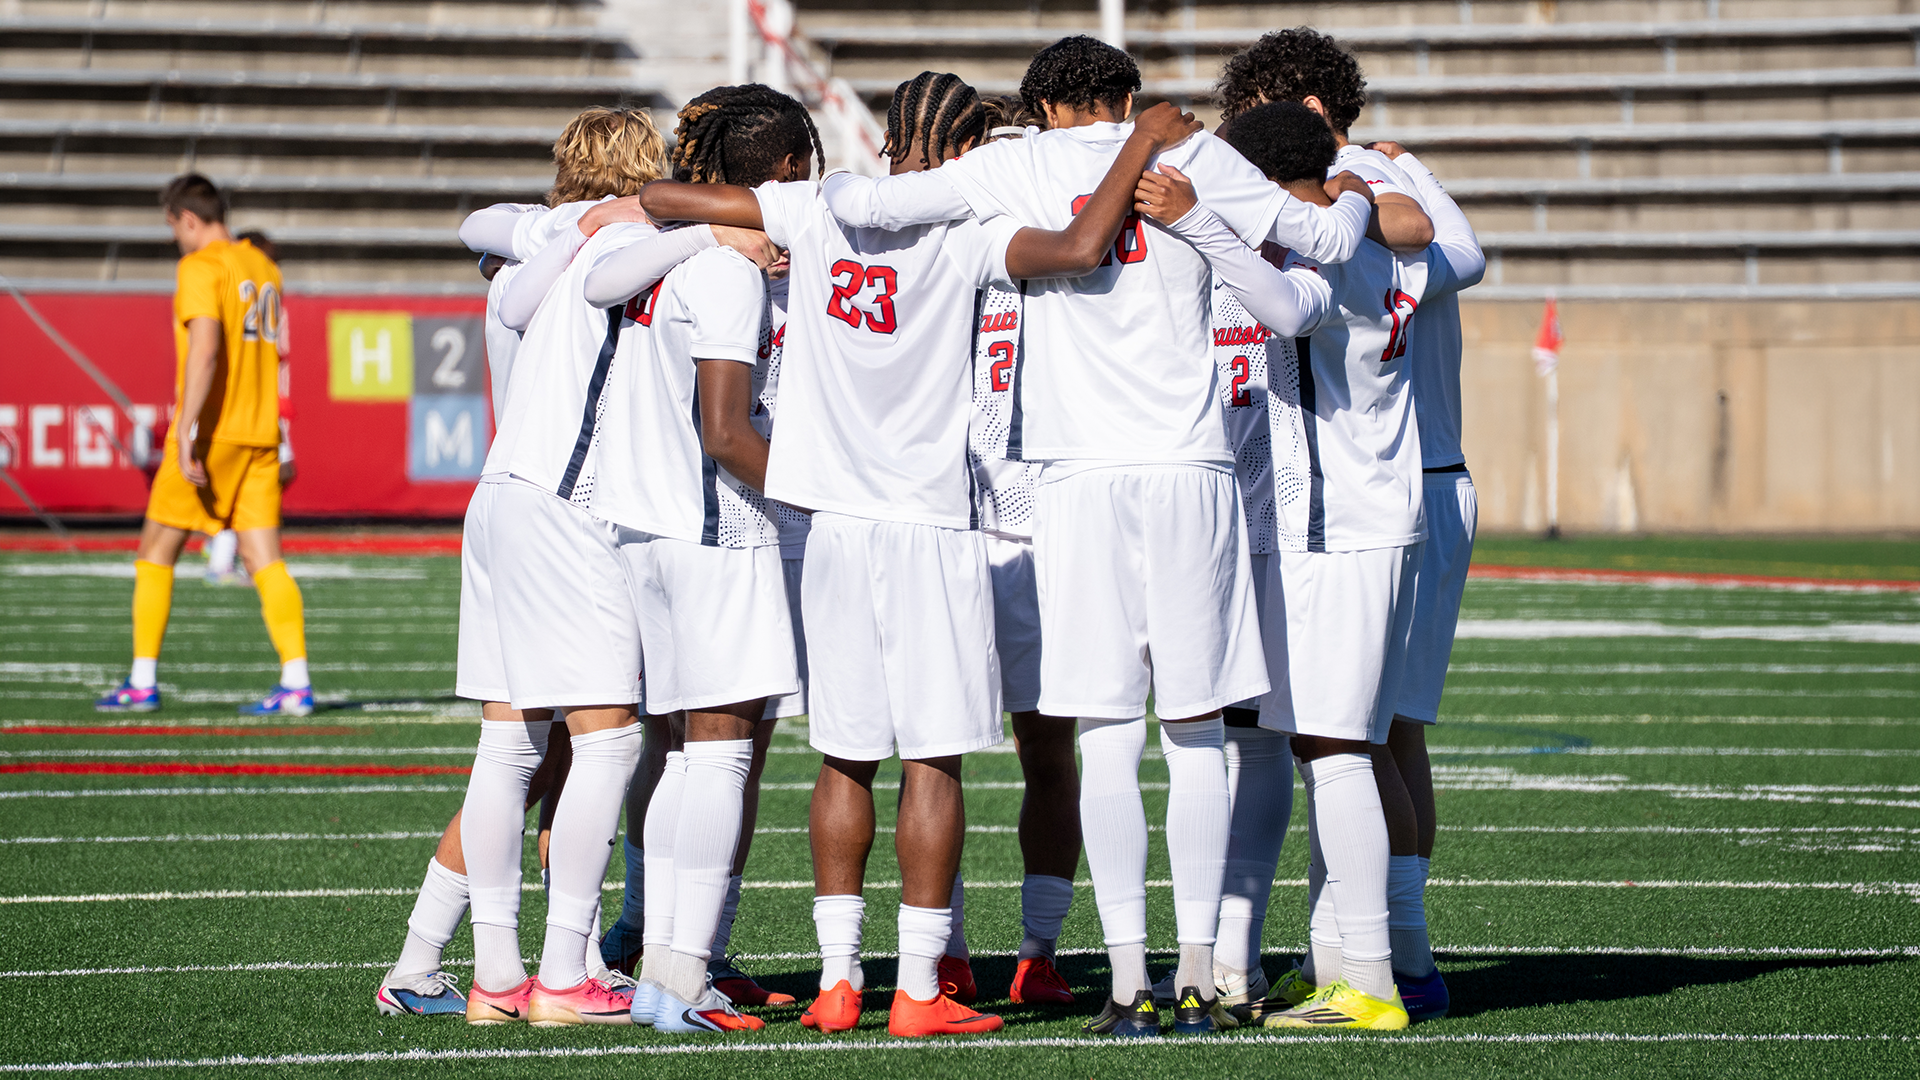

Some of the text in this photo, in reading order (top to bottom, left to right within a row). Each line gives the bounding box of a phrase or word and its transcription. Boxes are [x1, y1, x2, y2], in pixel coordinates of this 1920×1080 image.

[238, 279, 281, 343] 20
[826, 258, 898, 335] 23
[1379, 288, 1418, 362] 12
[350, 326, 466, 388] H 2
[1231, 355, 1252, 407] 2
[425, 410, 473, 468] M
